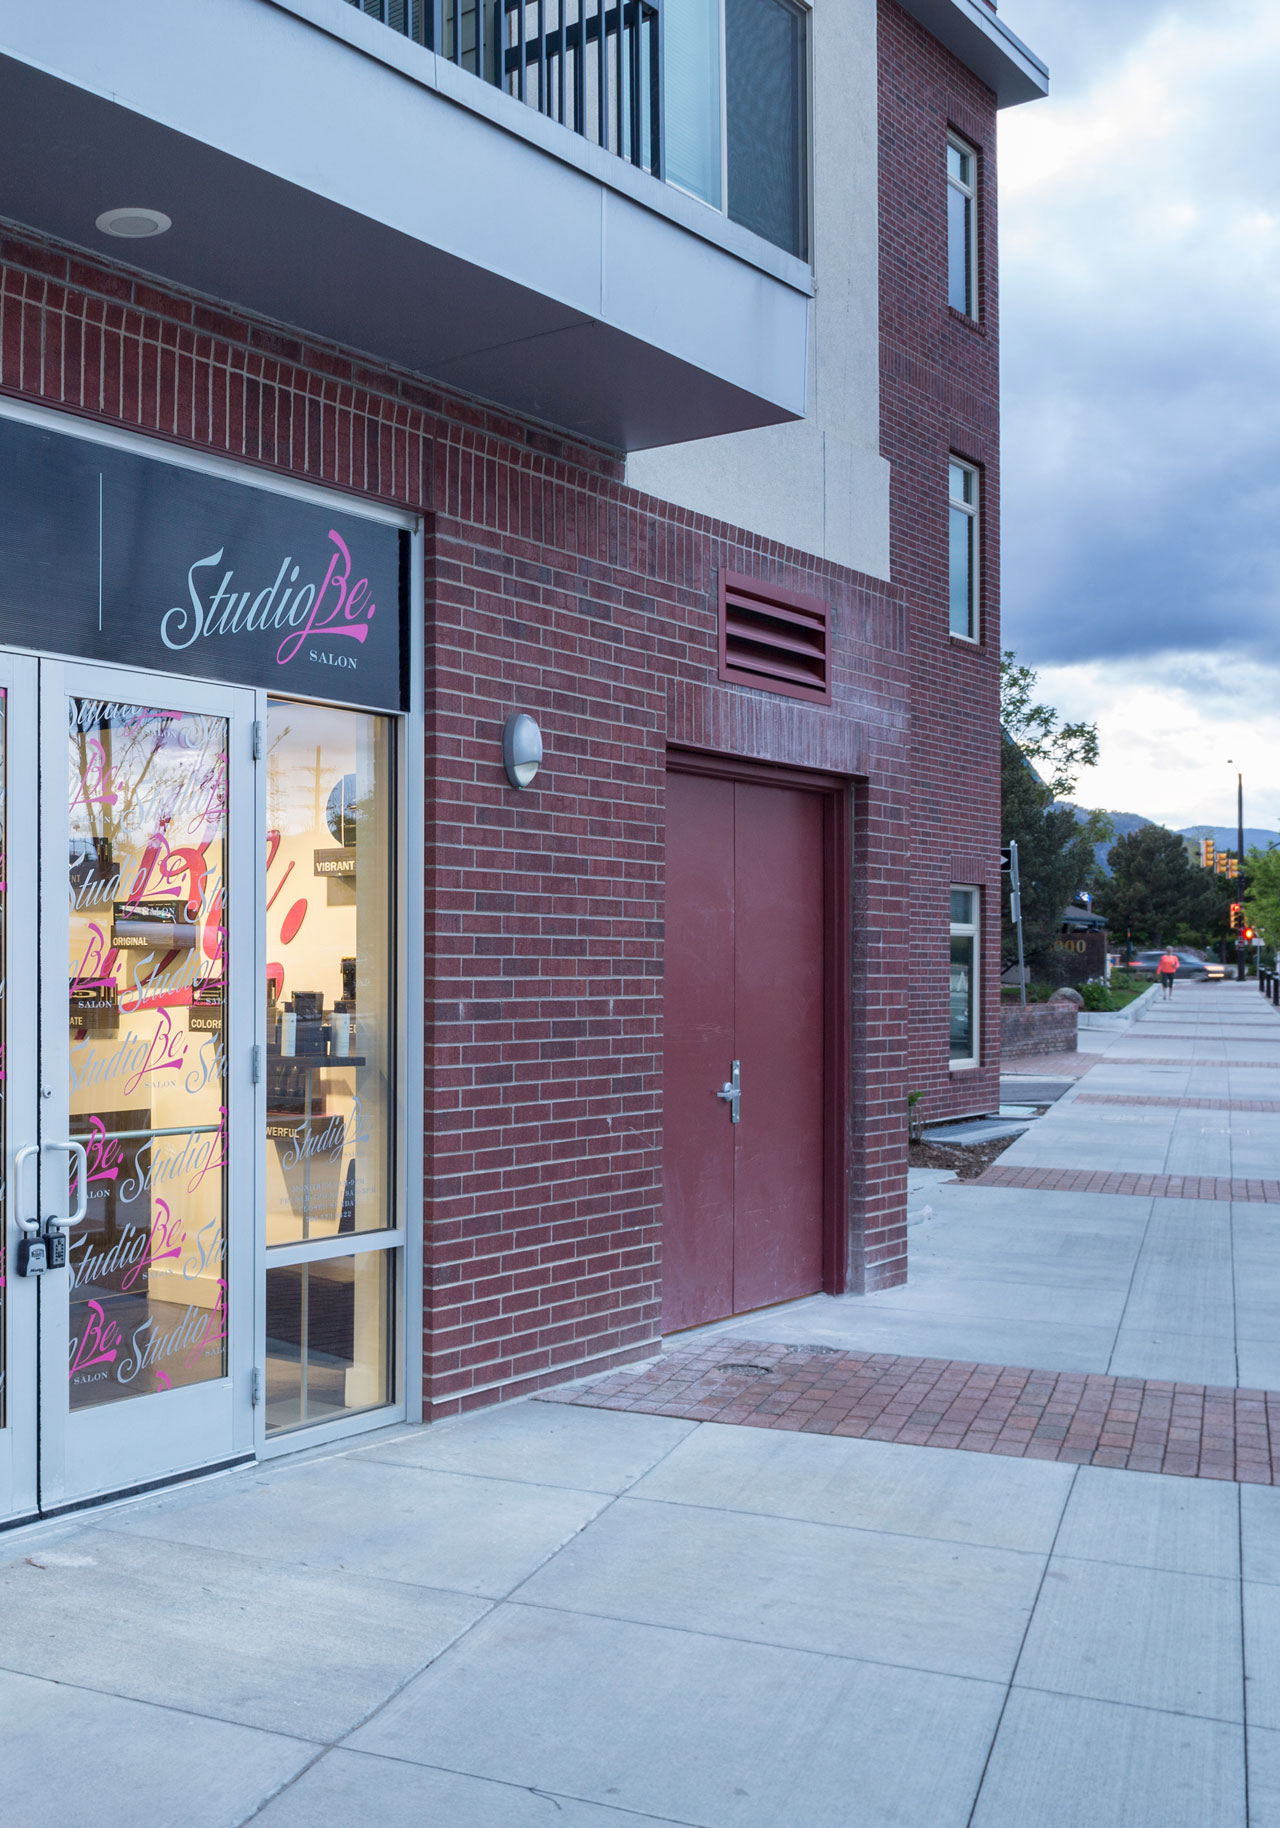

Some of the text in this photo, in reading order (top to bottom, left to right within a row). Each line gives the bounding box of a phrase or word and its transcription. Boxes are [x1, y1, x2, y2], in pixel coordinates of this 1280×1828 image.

[309, 649, 357, 670] SALON
[316, 860, 355, 872] VIBRANT
[112, 936, 148, 946] ORIGINAL
[77, 1000, 113, 1010] SALON
[77, 1189, 111, 1201] ALON
[73, 1371, 109, 1385] SALON
